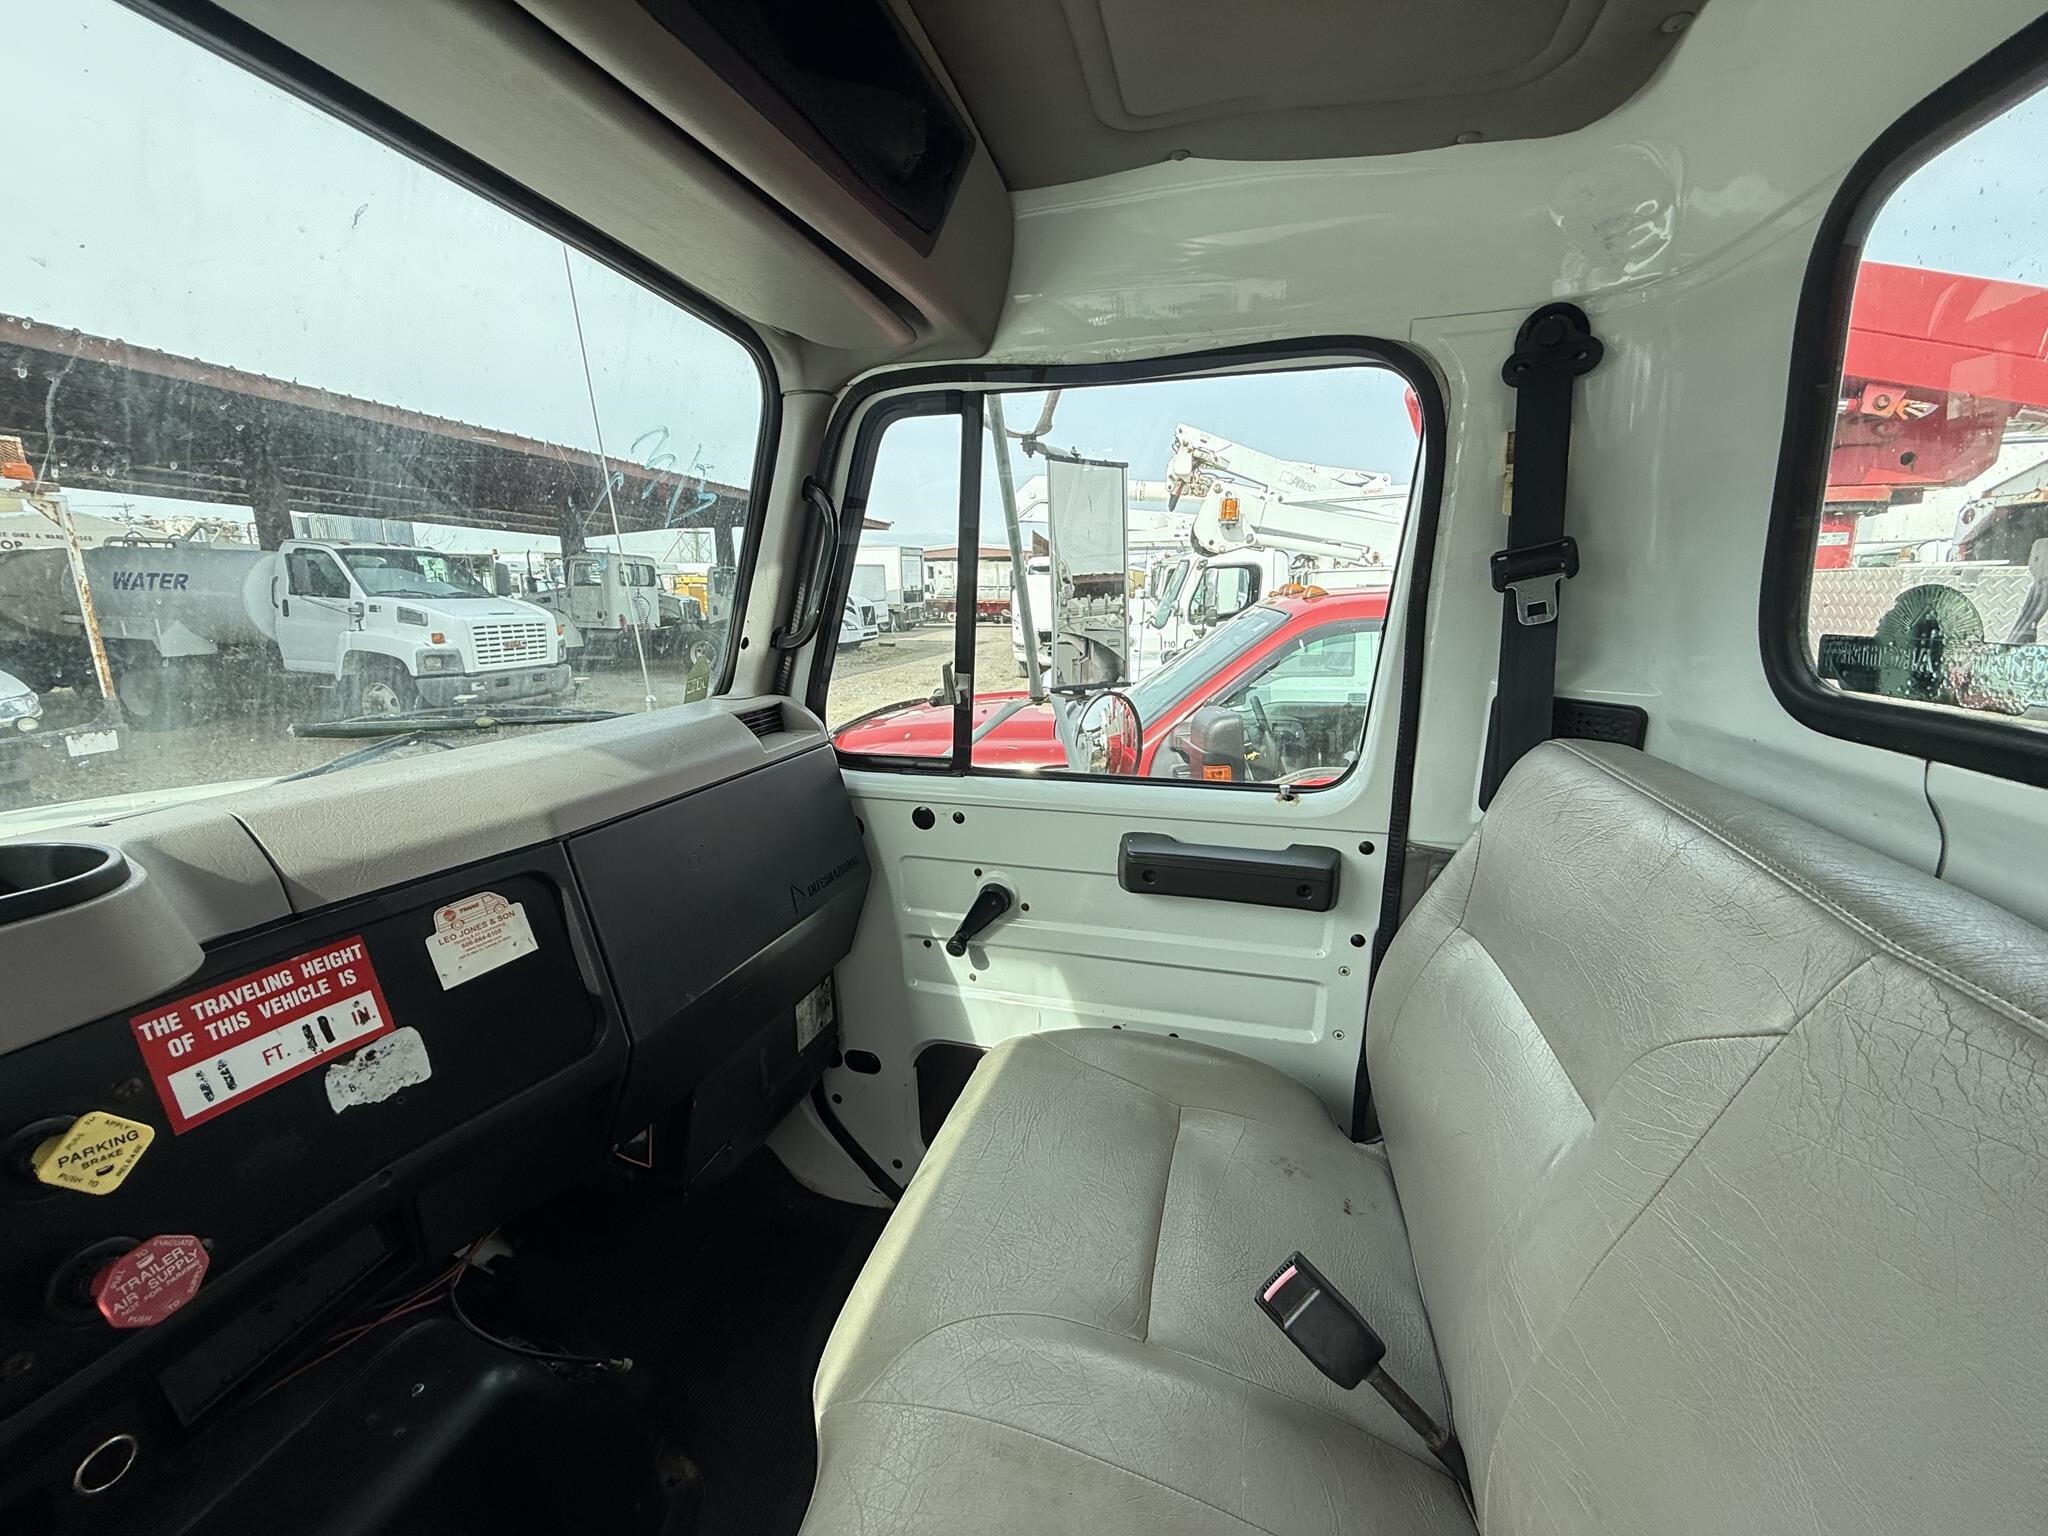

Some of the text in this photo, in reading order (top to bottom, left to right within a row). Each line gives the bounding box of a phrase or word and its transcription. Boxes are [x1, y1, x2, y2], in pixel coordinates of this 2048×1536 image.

[1292, 475, 1317, 492] Altec
[112, 570, 189, 591] WATER
[1163, 640, 1176, 649] T10
[438, 933, 457, 946] LEO
[459, 920, 488, 938] JONES
[489, 918, 497, 926] &
[497, 910, 515, 921] SON
[138, 944, 363, 1041] THE TRAVELING HEIGHT
[167, 968, 357, 1058] OF THIS VEHICLE IS
[262, 1043, 292, 1067] FT.
[104, 1119, 131, 1130] APPLY
[57, 1129, 140, 1168] PARKING
[81, 1148, 123, 1170] BRAKE
[57, 1172, 84, 1184] PUSH
[116, 1144, 144, 1177] RELEASE
[136, 1249, 149, 1258] TO
[113, 1248, 199, 1313] AIR SUPPLY
[116, 1247, 186, 1295] TRAILER
[166, 1260, 200, 1287] PARKING
[128, 1315, 152, 1323] PUSH
[168, 1300, 180, 1310] TO
